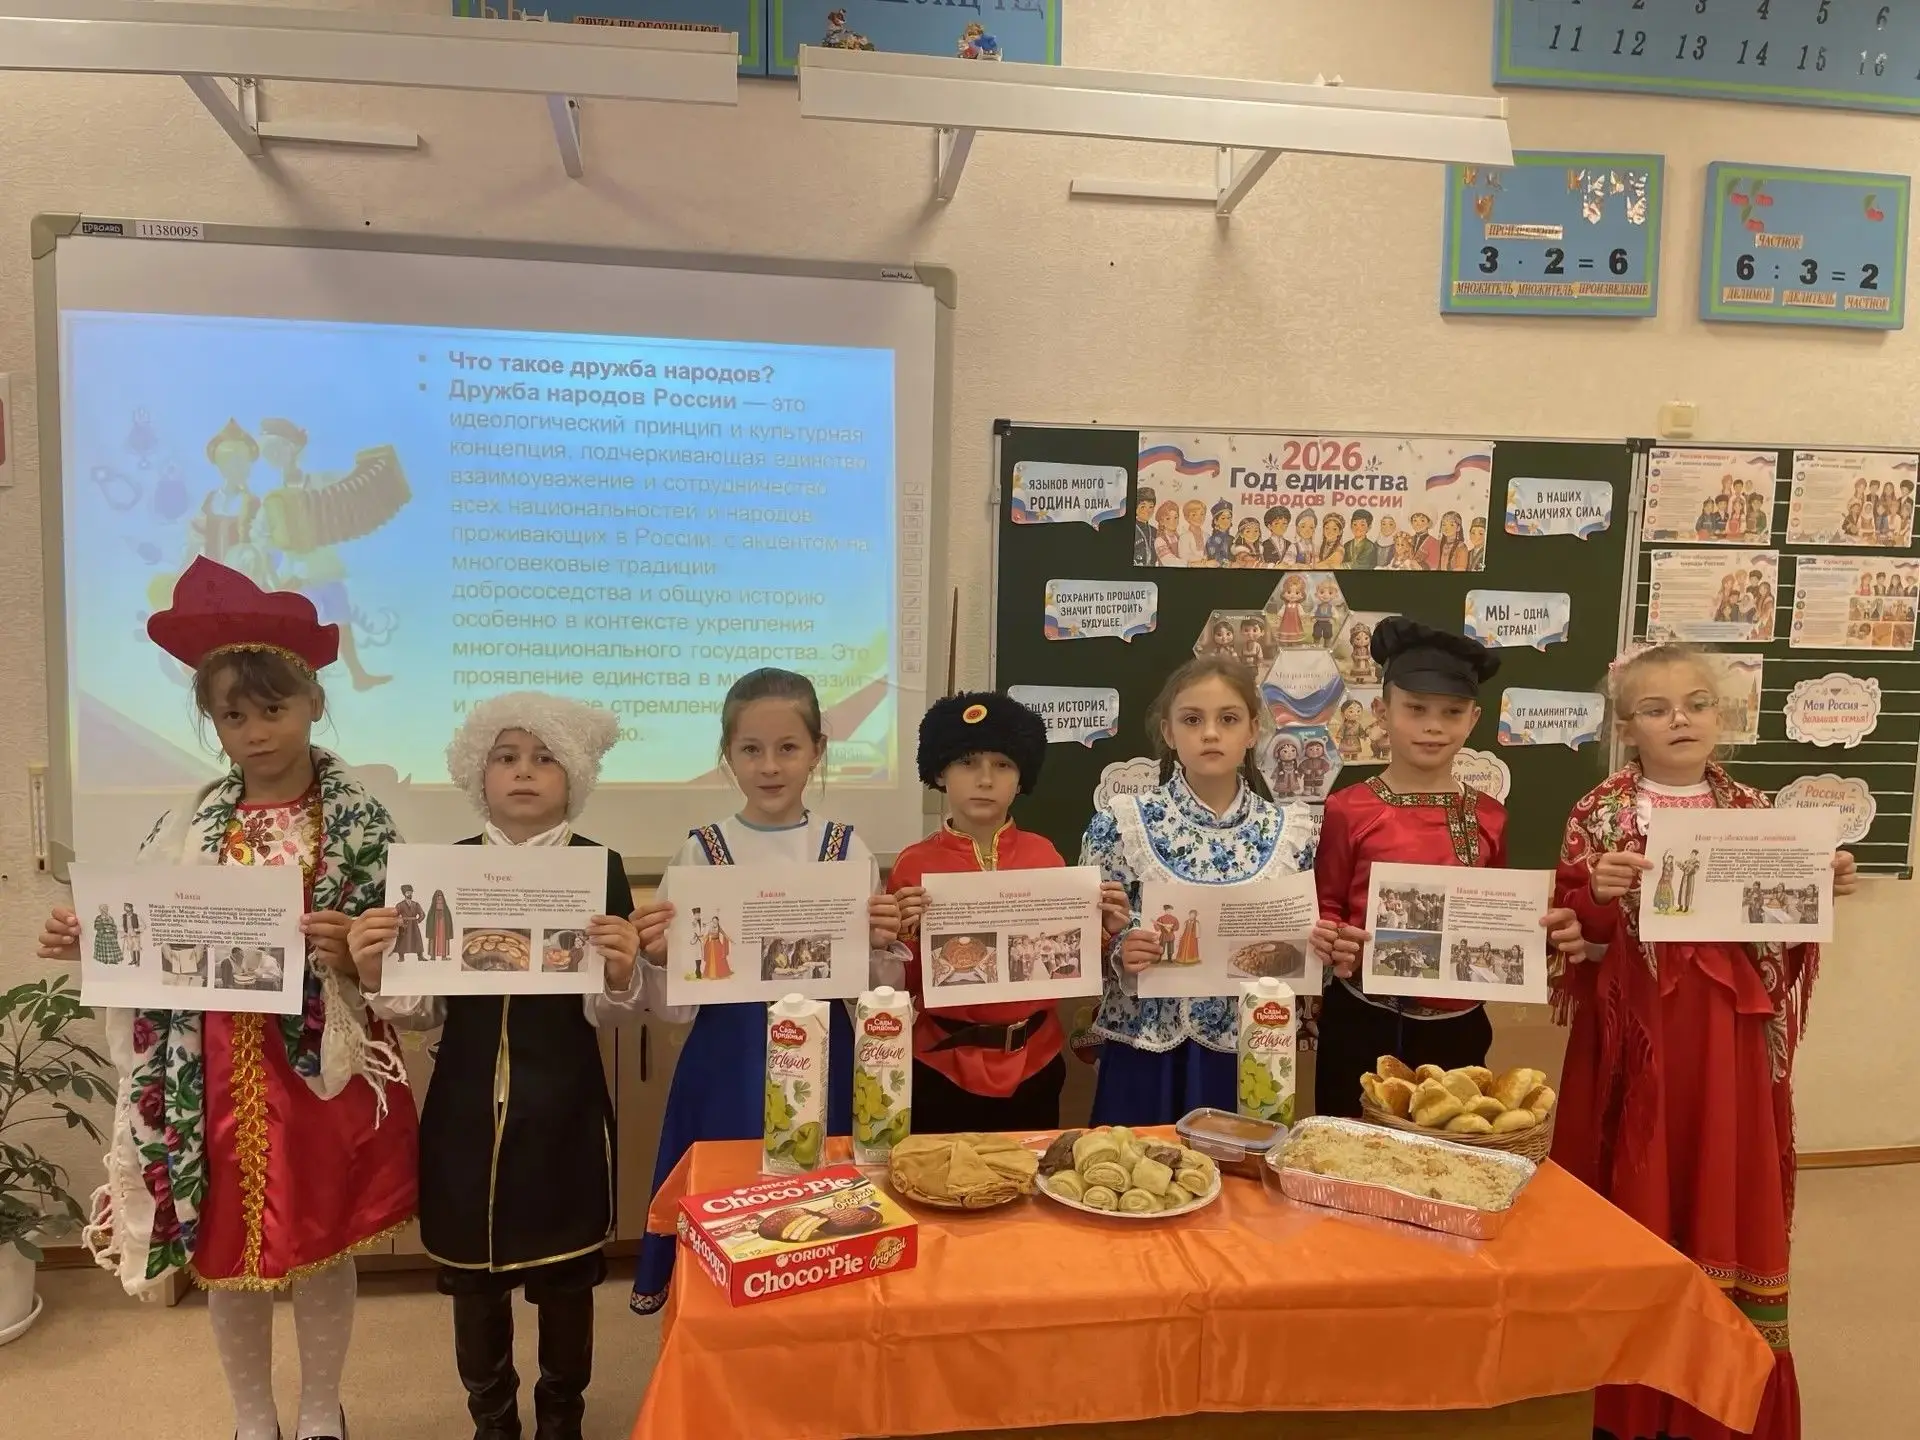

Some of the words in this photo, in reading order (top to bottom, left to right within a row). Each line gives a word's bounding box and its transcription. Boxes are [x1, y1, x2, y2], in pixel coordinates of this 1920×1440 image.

[1816, 0, 1831, 24] 5
[1549, 24, 1582, 52] 11
[1613, 29, 1646, 56] 12
[1675, 34, 1708, 61] 13
[1737, 40, 1769, 66] 14
[1797, 45, 1827, 71] 15
[141, 224, 199, 238] 11380095
[1479, 246, 1499, 274] 3
[1544, 248, 1565, 274] 2
[1609, 248, 1629, 275] 6
[1736, 254, 1755, 281] 6
[1800, 259, 1818, 285] 3
[1859, 263, 1879, 290] 2
[1456, 282, 1514, 294] МНОЖИТЕЛЬ
[1517, 284, 1574, 296] МНОЖИТЕЛЬ
[1579, 283, 1648, 295] ПРОИЗВЕДЕНИЕ
[1727, 288, 1772, 301] ДЕЛИМОЕ
[1787, 292, 1835, 305] ДЕЛИТЕЛЬ
[449, 350, 492, 371] Что
[500, 357, 564, 373] такое
[570, 359, 656, 381] дружба
[664, 364, 775, 385] народов?
[449, 379, 539, 403] Дружба
[547, 387, 645, 407] народов
[654, 388, 737, 409] России
[772, 398, 806, 412] это
[450, 411, 625, 434] идеологический
[635, 419, 721, 439] принцип
[731, 424, 742, 438] и
[750, 424, 863, 447] культурная
[581, 445, 766, 468] подчеркивающая
[1282, 440, 1363, 472] 2026
[450, 470, 634, 490] взаимоуважение
[645, 478, 655, 490] и
[1028, 478, 1068, 490] ЯЗЫКОВ
[1072, 478, 1104, 489] МНОГО
[1230, 467, 1278, 493] Год
[1285, 472, 1409, 493] единства
[1030, 496, 1081, 510] РОДИНА
[1084, 498, 1113, 510] ОДНА.
[1241, 491, 1326, 509] народов
[1332, 491, 1403, 509] России
[1537, 491, 1544, 504] В
[1546, 490, 1582, 503] НАШИХ
[451, 499, 501, 514] всех
[509, 500, 698, 520] национальностей
[1514, 507, 1572, 520] РАЗЛИЧИЯХ
[452, 526, 607, 548] проживающих
[617, 532, 627, 545] в
[452, 556, 610, 574] многовековые
[618, 558, 716, 576] традиции
[452, 580, 632, 602] добрососедства
[641, 588, 651, 601] и
[659, 585, 731, 606] общую
[741, 590, 825, 606] историю
[1056, 592, 1104, 604] СОХРАНИТЬ
[1107, 590, 1146, 601] ПРОШЛОЕ
[1060, 606, 1093, 617] ЗНАЧИТ
[1096, 604, 1143, 615] ПОСТРОИТЬ
[1485, 604, 1510, 622] МЫ
[1523, 608, 1549, 621] ОДНА
[452, 609, 557, 629] особенно
[566, 615, 577, 629] в
[584, 615, 689, 631] контексте
[697, 617, 815, 637] укрепления
[1497, 624, 1537, 637] СТРАНА!
[453, 642, 682, 660] многонационального
[831, 643, 870, 662] Это
[453, 669, 584, 687] проявление
[593, 671, 691, 688] единства
[700, 674, 710, 686] в
[453, 700, 466, 713] и
[610, 699, 724, 716] стремлени
[1024, 701, 1055, 714] БЩАЯ
[1516, 707, 1526, 717] ОТ
[1528, 706, 1588, 718] КАЛИНИНГРАДА
[1803, 699, 1825, 711] Моя
[1828, 699, 1859, 712] Россия
[1057, 716, 1109, 729] БУДУЩЕЕ.
[1842, 711, 1870, 724] семья!
[1524, 721, 1535, 730] ДО
[1113, 781, 1138, 795] Одна
[1803, 785, 1846, 800] Россия
[1256, 1013, 1289, 1021] Придонья
[1263, 1007, 1282, 1015] Сады
[867, 1023, 900, 1032] Придонья
[874, 1018, 893, 1026] Сады
[773, 1030, 804, 1042] Придонья
[778, 1025, 797, 1034] Сады
[750, 1178, 800, 1193] ORION
[834, 1187, 876, 1210] Original
[791, 1245, 836, 1264] ORION
[869, 1237, 907, 1271] Original
